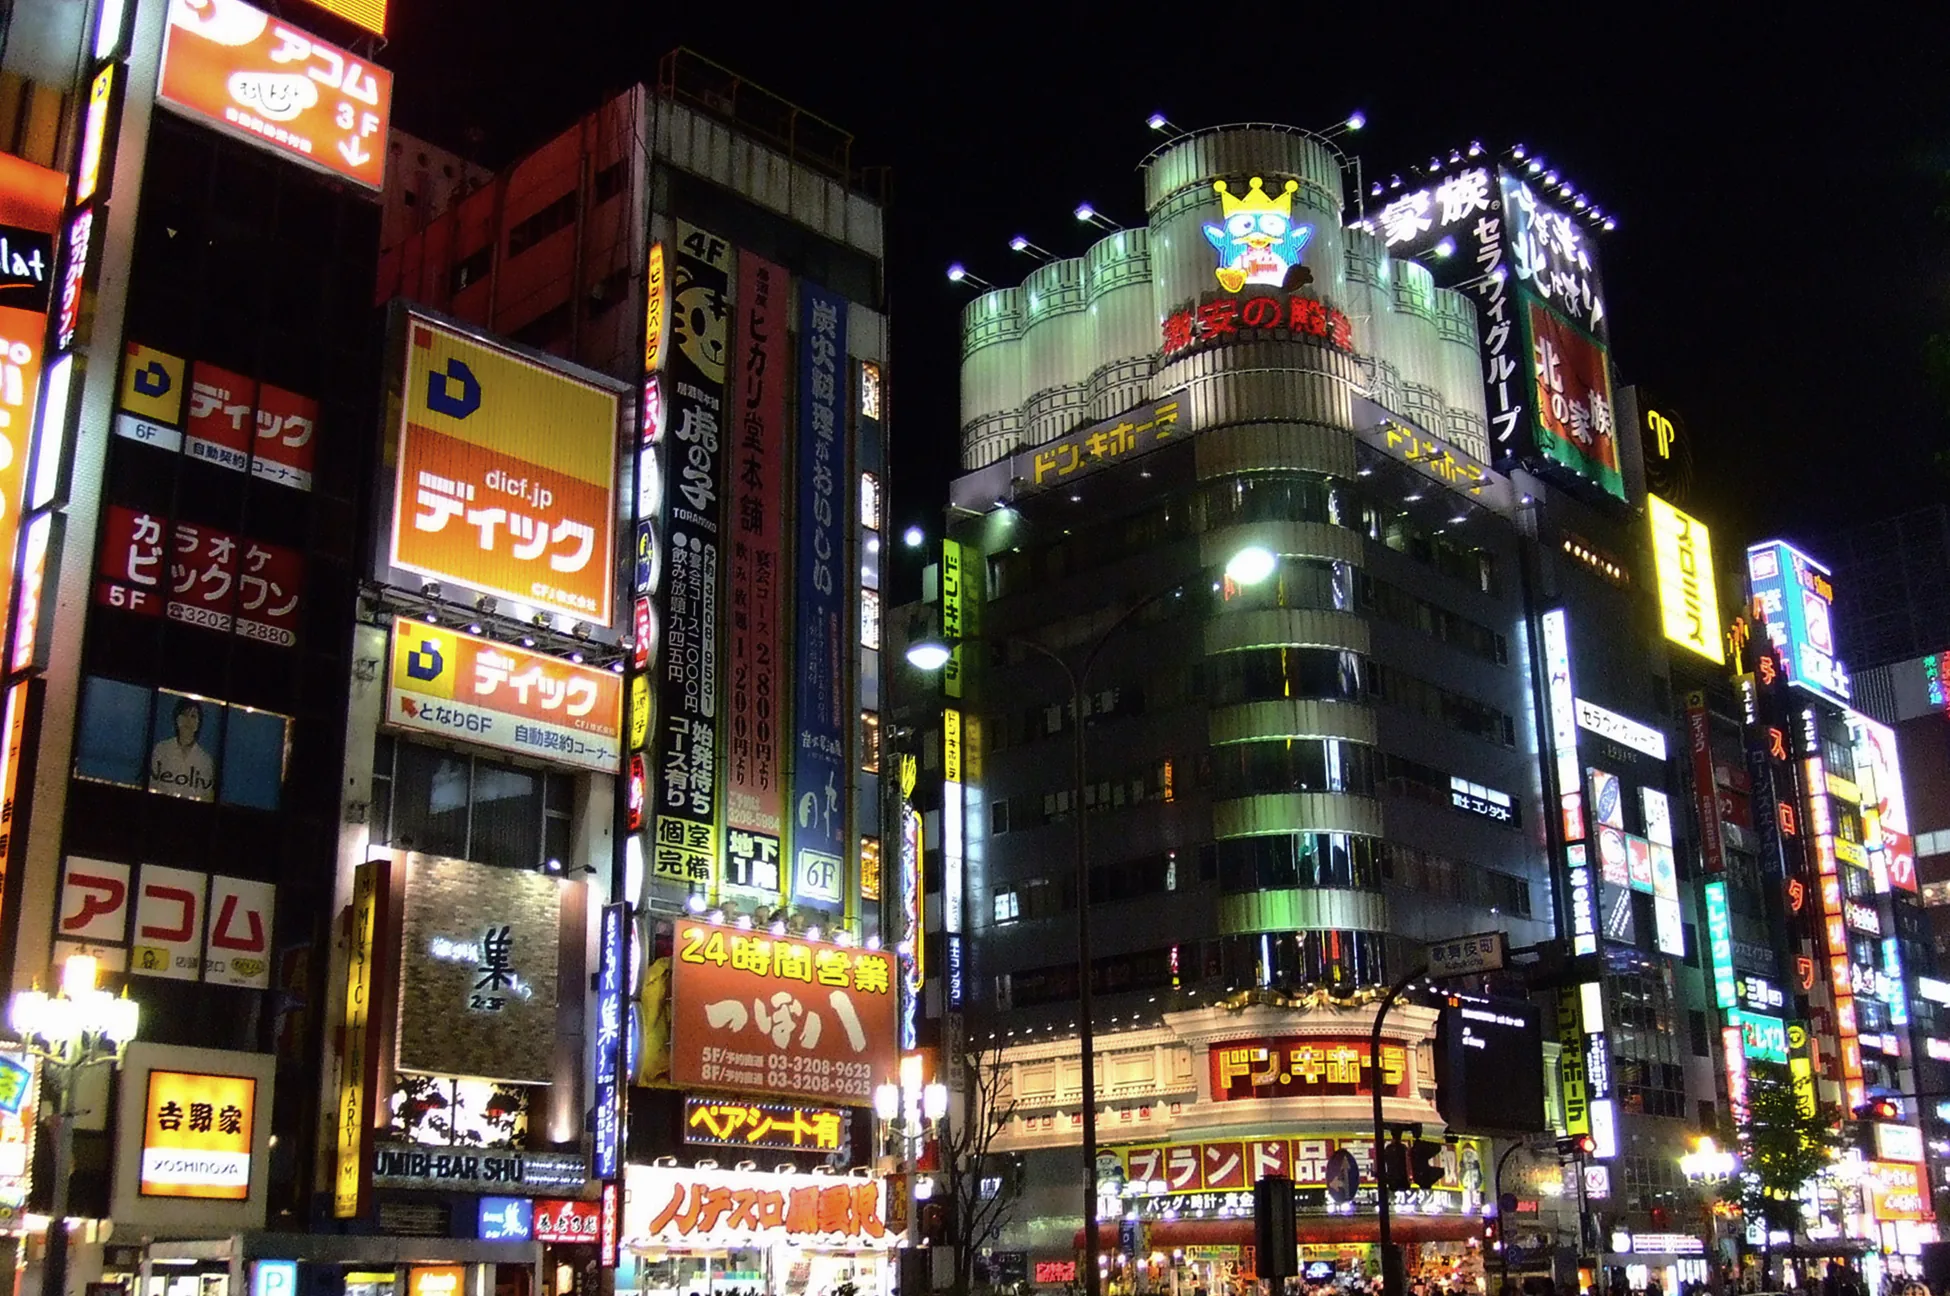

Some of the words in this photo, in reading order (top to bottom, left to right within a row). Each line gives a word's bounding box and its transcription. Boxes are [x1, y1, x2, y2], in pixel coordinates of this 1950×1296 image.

[270, 26, 378, 106] アコム
[1379, 166, 1490, 248] 家族
[683, 232, 726, 264] 4F
[1473, 216, 1522, 443] セラヴィグループ
[1534, 336, 1613, 447] 北の家族
[135, 423, 157, 440] 6F
[189, 381, 314, 448] ディック
[193, 442, 301, 481] 自動契約コーナー
[675, 404, 718, 511] 虎の子
[485, 470, 553, 509] dicf.jp
[131, 513, 273, 563] カラオケ
[414, 471, 595, 574] ディック
[109, 584, 147, 610] 5F
[126, 543, 299, 617] ビックワン
[185, 608, 291, 645] 3202-2880
[474, 650, 598, 717] ディック
[419, 702, 493, 734] となり6F
[514, 723, 619, 760] 自動契約コーナー
[664, 715, 690, 810] コース有り
[690, 718, 715, 817] 始発待ち
[658, 817, 712, 850] 個室
[729, 829, 779, 862] 地下
[655, 850, 713, 884] 完備
[806, 862, 836, 890] 6F
[63, 872, 265, 953] アコム
[354, 906, 370, 1006] MUSIC
[475, 925, 515, 991] 集
[681, 927, 890, 994] 24時間営業
[1431, 938, 1493, 961] 歌舞伎町
[704, 990, 867, 1053] つぼ八
[767, 1071, 871, 1096] 03-3208-9625
[768, 1053, 872, 1079] 03-3208-9623
[158, 1101, 242, 1134] 吉野家
[689, 1106, 841, 1149] ペアシート有
[153, 1159, 239, 1175] YOSHINOYA
[266, 1271, 284, 1296] P
